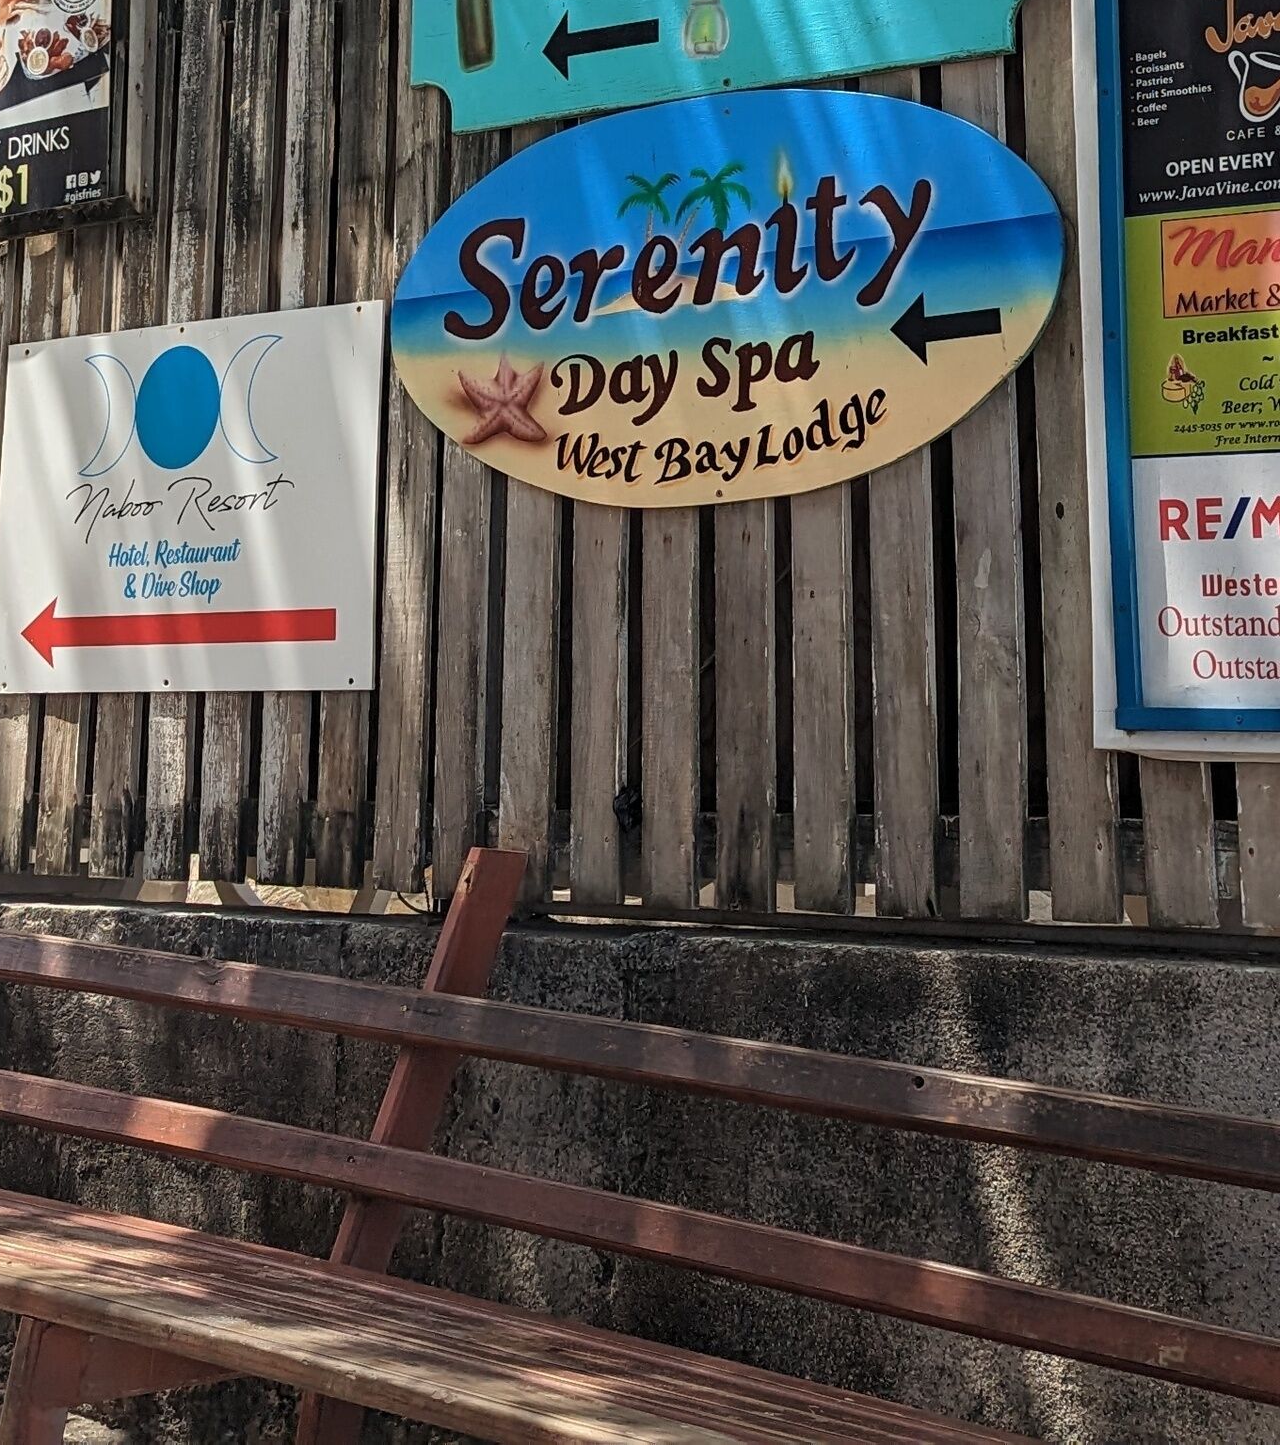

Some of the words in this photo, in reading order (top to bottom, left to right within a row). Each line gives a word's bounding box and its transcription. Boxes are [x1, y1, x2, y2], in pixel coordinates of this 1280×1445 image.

[1135, 50, 1167, 62] Bagels
[1135, 61, 1185, 75] Croissants
[7, 125, 70, 161] DRINKS
[1226, 127, 1266, 142] CAFE
[1165, 157, 1214, 178] OPEN
[1219, 150, 1275, 173] EVERY
[64, 187, 102, 204] #gisfries
[444, 176, 932, 341] Serenity
[1175, 288, 1260, 315] Market
[1182, 323, 1279, 345] Breakfast
[550, 350, 679, 427] Day
[696, 330, 820, 412] Spa
[1239, 374, 1275, 391] Cold
[556, 433, 647, 485] West
[654, 434, 752, 486] Bay
[755, 388, 889, 466] Lodge
[65, 478, 163, 544] Naboo
[167, 473, 295, 531] Resort
[108, 541, 150, 568] Hotel,
[154, 537, 241, 566] Restaurant
[141, 573, 177, 599] Dive
[178, 570, 222, 604] Shop
